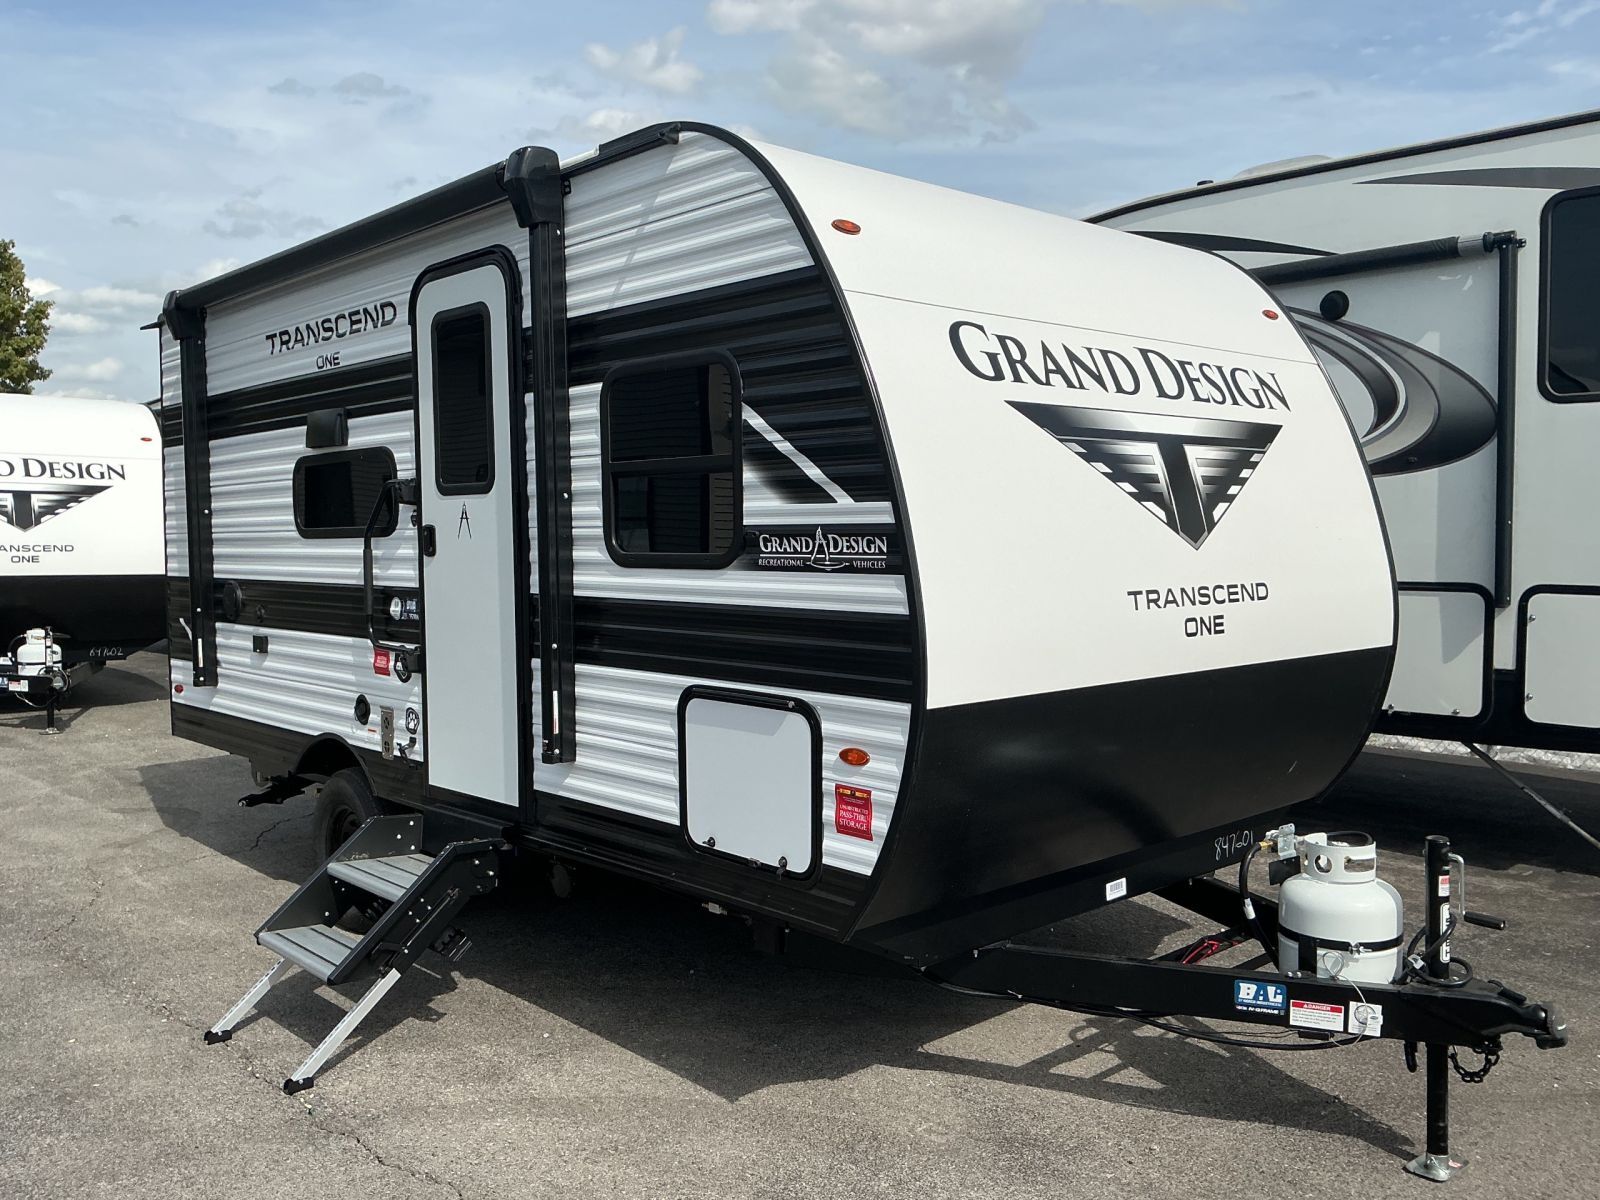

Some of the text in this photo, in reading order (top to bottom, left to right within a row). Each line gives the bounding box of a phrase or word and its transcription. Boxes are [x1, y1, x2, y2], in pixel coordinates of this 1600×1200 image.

[265, 300, 397, 355] TRANSCEND
[316, 351, 341, 370] ONE
[948, 320, 1291, 412] GRAND DESIGN
[21, 457, 126, 480] DESIGN
[759, 534, 887, 554] GRAND DESIGN
[10, 555, 40, 564] ONE
[758, 558, 886, 569] RECREATIONAL VEHICLES
[1127, 582, 1269, 611] TRANSCEND
[1184, 614, 1225, 638] ONE
[1214, 830, 1254, 861] 847601
[1239, 982, 1283, 1003] BAL
